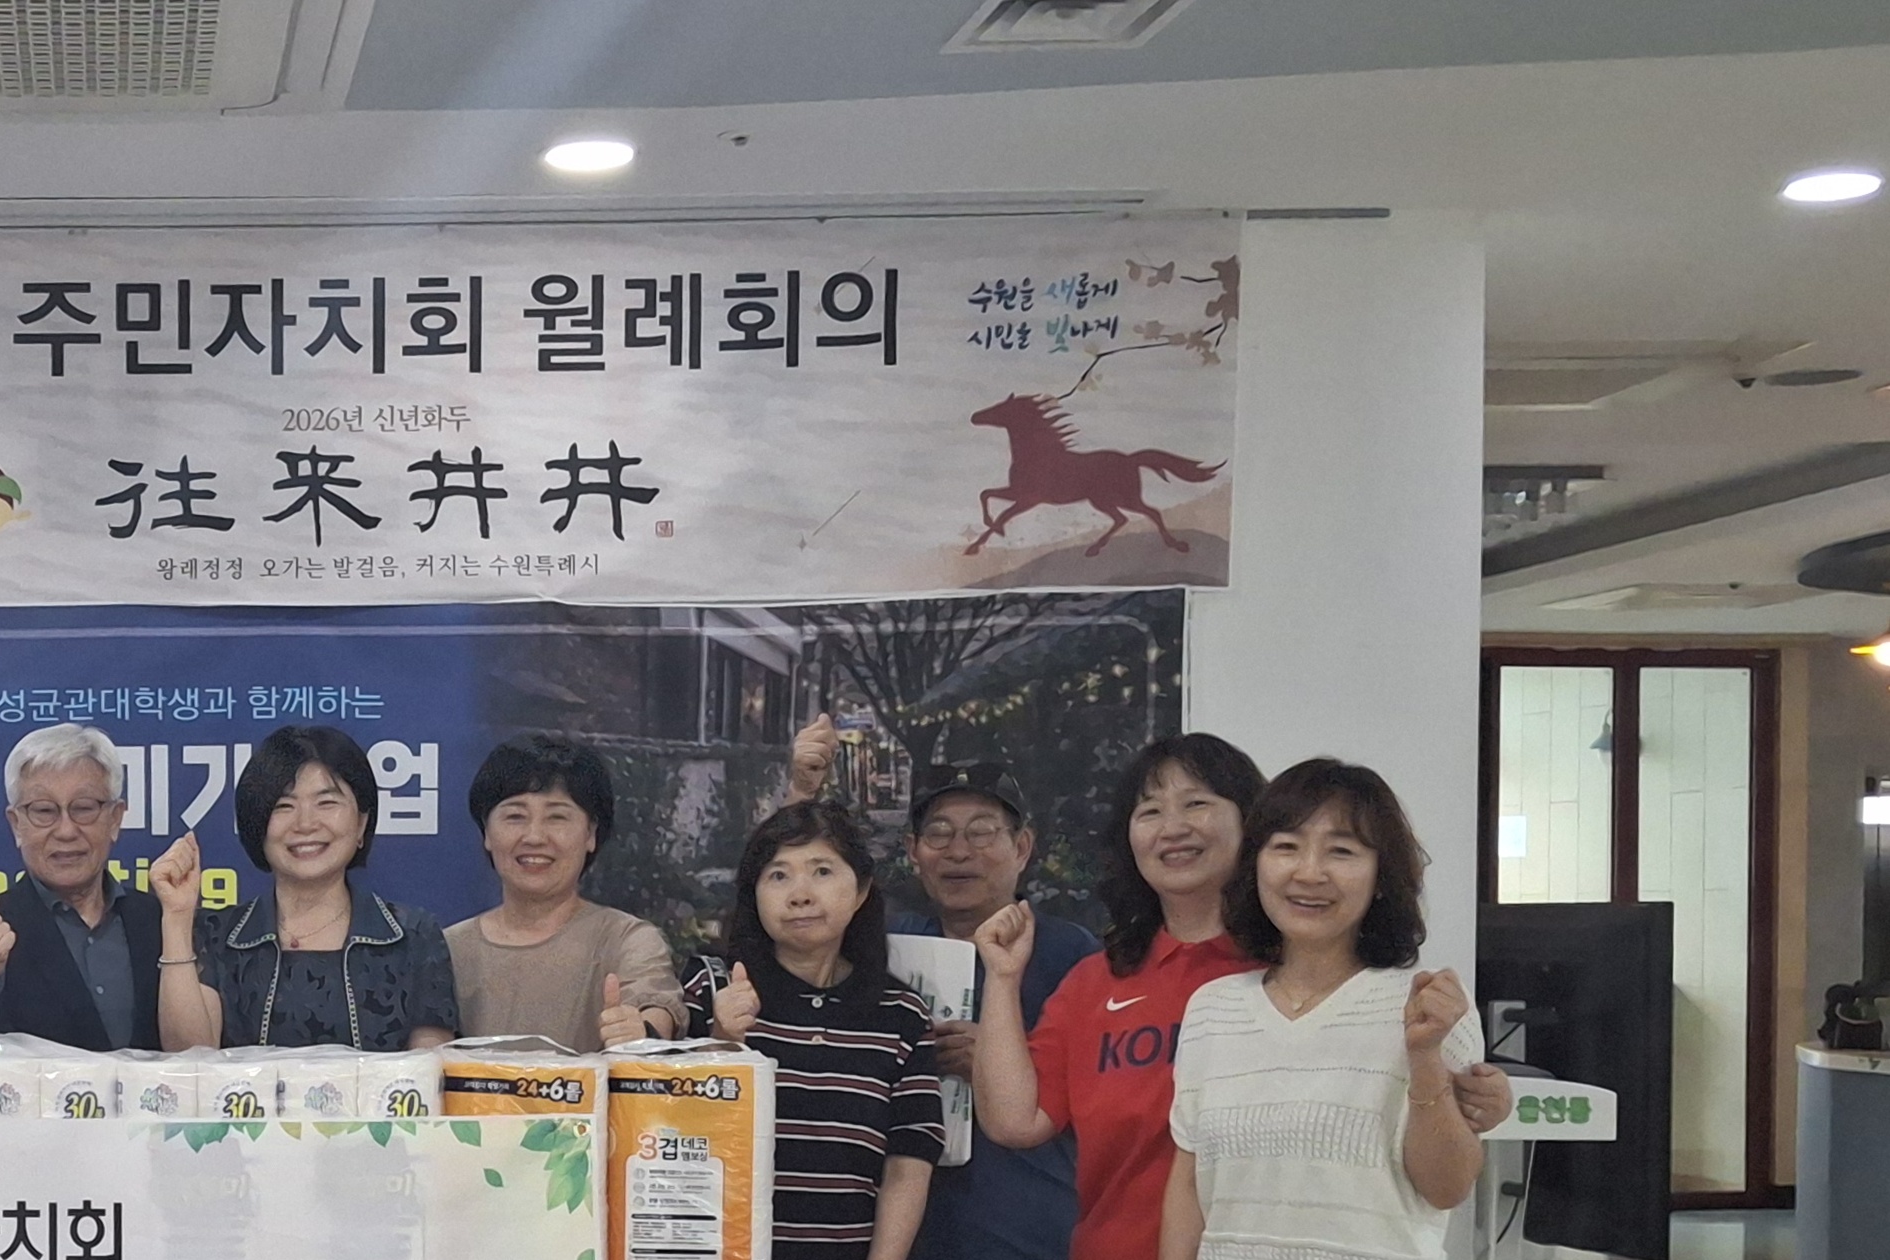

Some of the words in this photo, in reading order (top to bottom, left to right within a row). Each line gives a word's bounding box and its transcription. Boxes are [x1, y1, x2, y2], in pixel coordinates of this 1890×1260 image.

[968, 277, 1036, 313] 수원을
[1042, 272, 1119, 310] 새롭게
[12, 273, 484, 377] 주민자치회
[522, 266, 900, 372] 월례회의
[967, 321, 1032, 351] 시민을
[1046, 313, 1119, 353] 빛나게
[281, 405, 365, 434] 2026년
[372, 404, 472, 433] 신년화두
[156, 556, 244, 581] 왕래정정
[259, 556, 326, 580] 오가는
[333, 555, 407, 579] 발걸음,
[415, 555, 482, 578] 커지는
[489, 552, 600, 578] 수원특례시
[246, 685, 386, 720] 함께하는
[119, 742, 253, 837] 미기
[373, 741, 439, 836] 업
